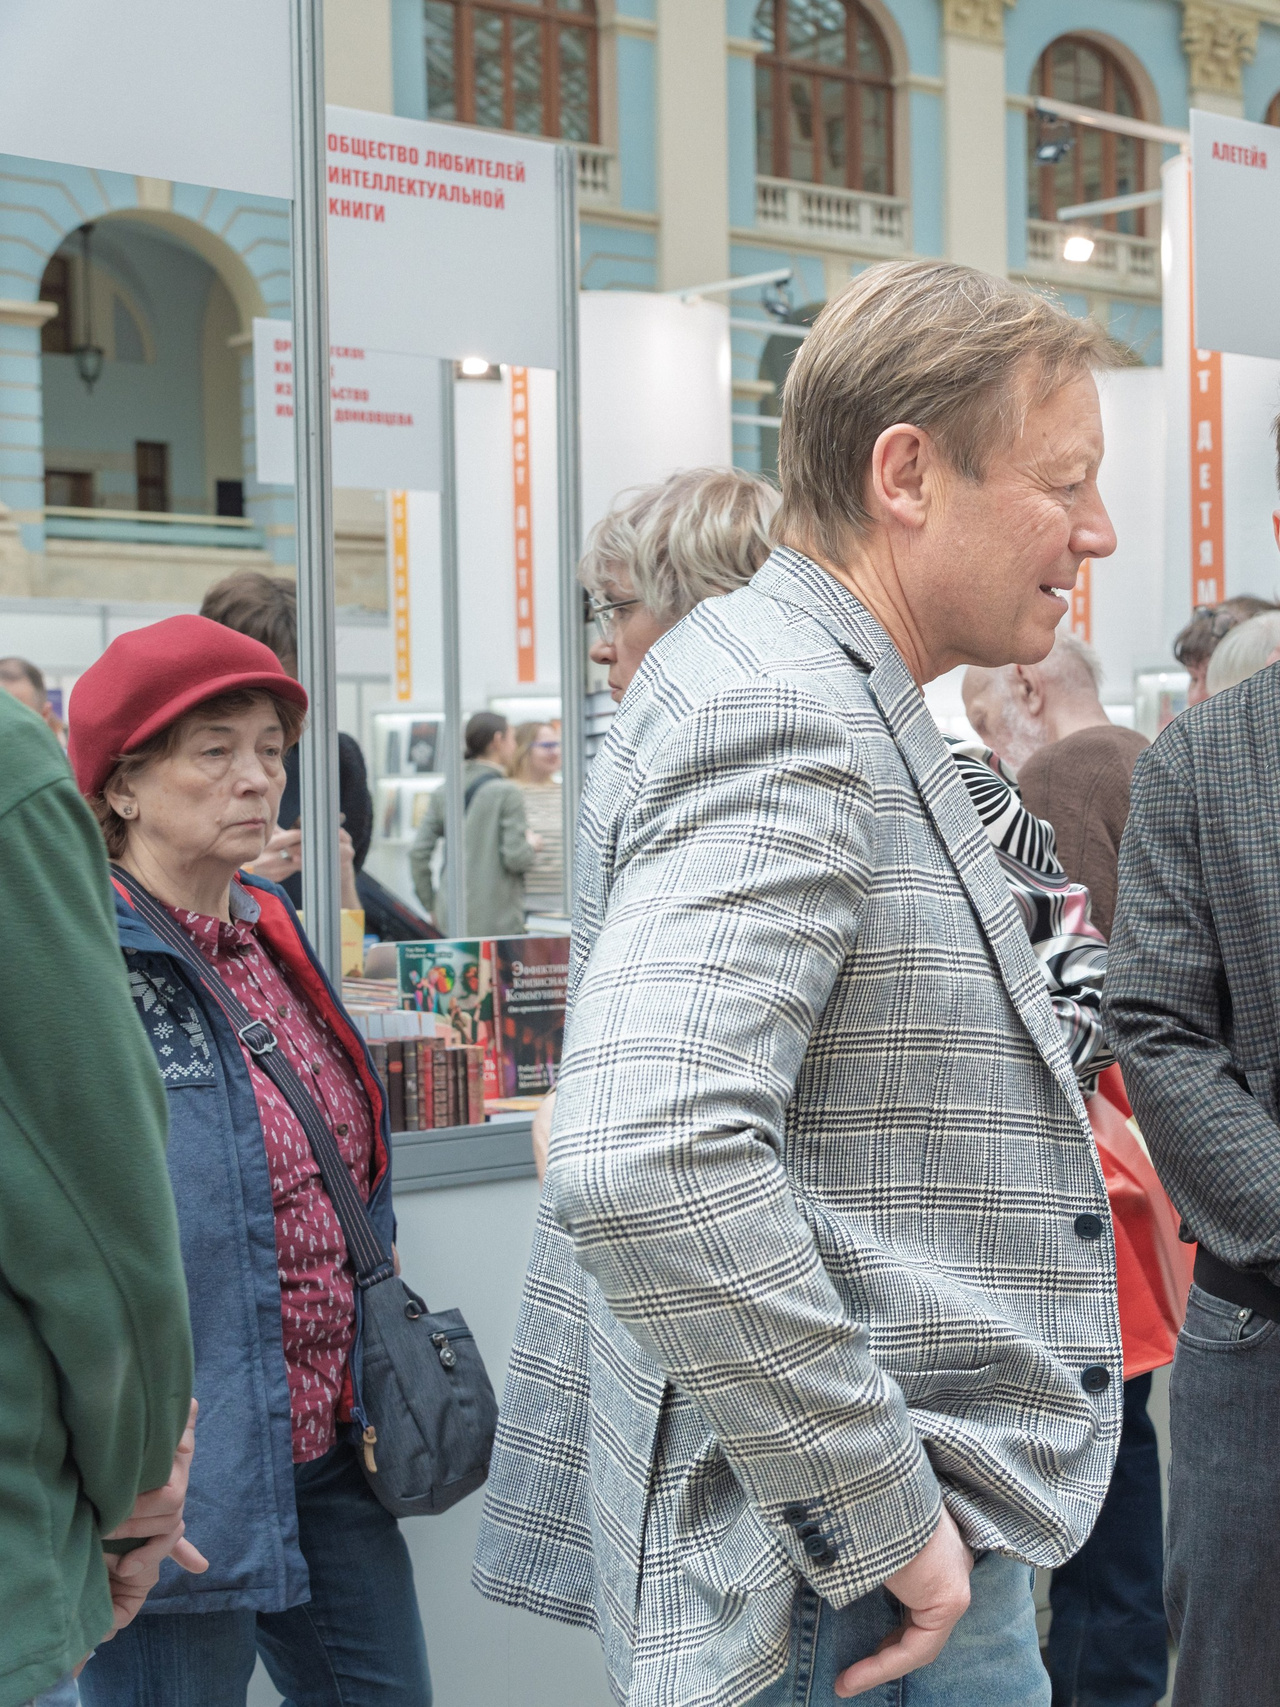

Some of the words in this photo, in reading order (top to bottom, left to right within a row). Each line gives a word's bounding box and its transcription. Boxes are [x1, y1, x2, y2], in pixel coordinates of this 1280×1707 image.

[328, 133, 419, 165] ОБЩЕСТВО
[425, 150, 526, 183] ЛЮБИТЕЛЕЙ
[1212, 141, 1267, 170] АЛЕТЕЙЯ
[328, 165, 505, 210] ИНТЕЛЛЕКТУАЛЬНОЙ
[328, 197, 386, 223] КНИГИ
[1197, 420, 1216, 604] ДЕТЯМ
